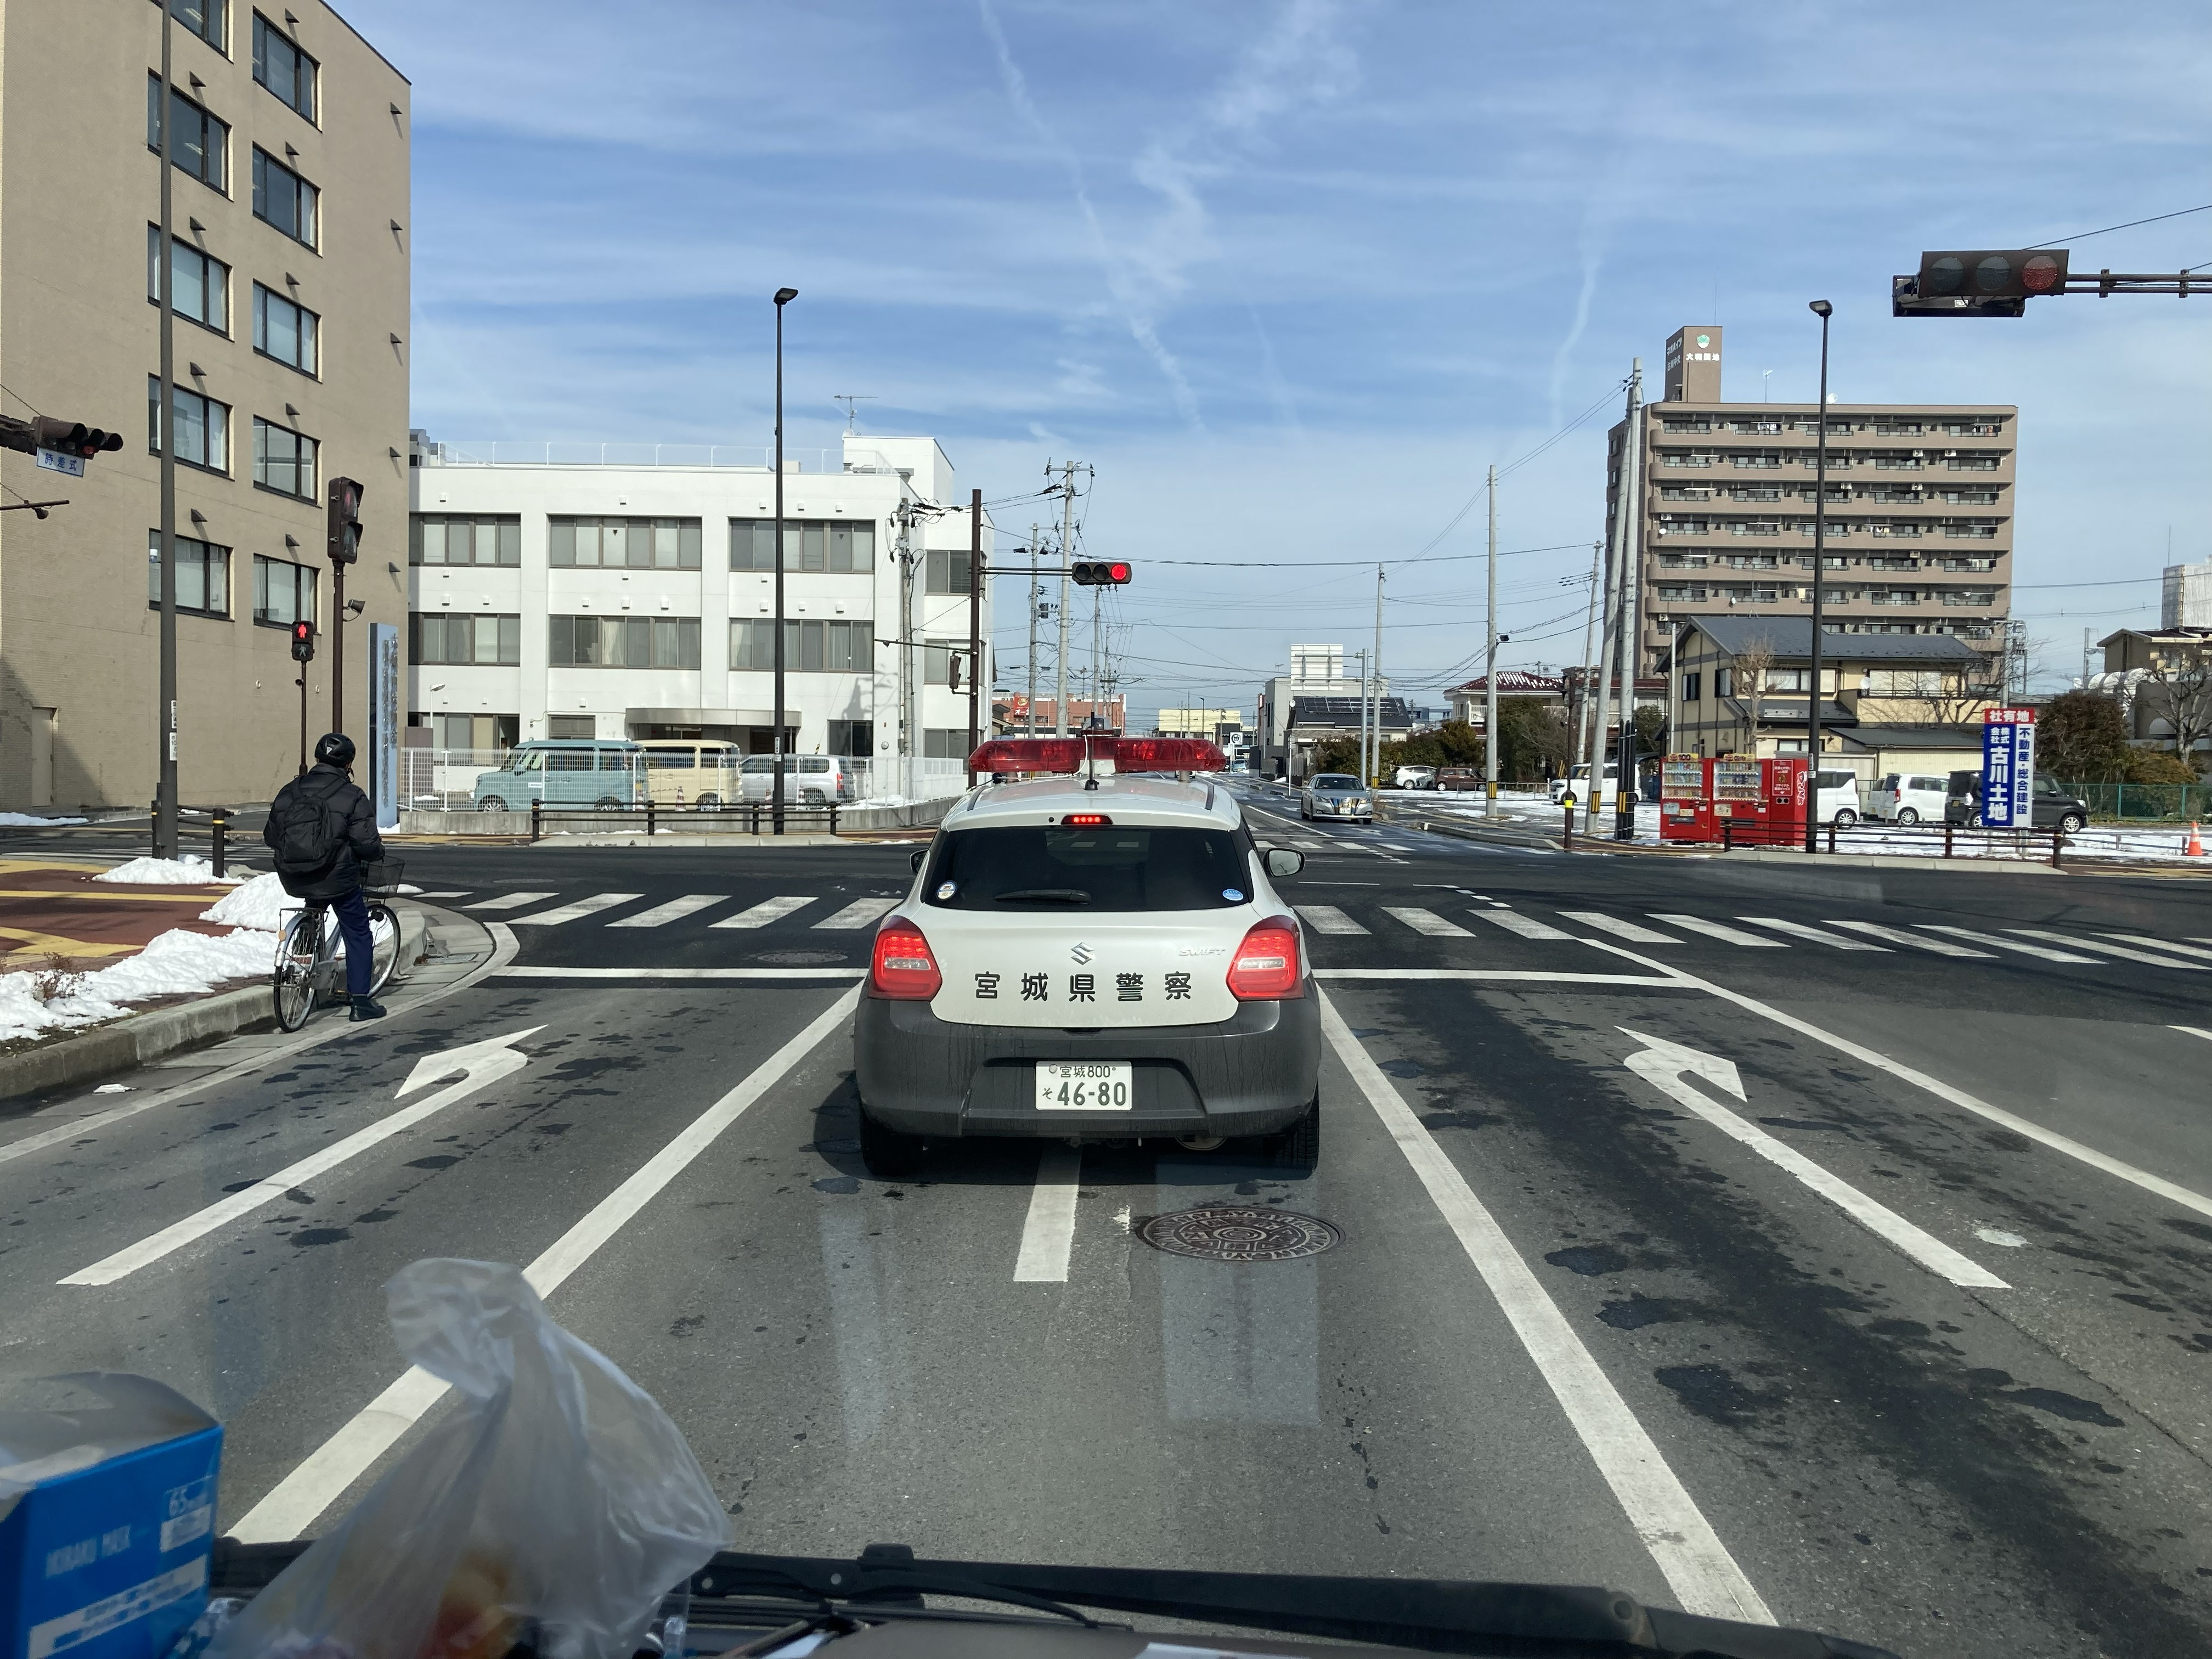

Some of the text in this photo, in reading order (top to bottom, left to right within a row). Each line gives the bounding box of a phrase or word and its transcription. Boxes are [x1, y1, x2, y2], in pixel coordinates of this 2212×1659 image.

[45, 453, 77, 471] 時差式
[1989, 710, 2030, 723] 社有地
[1988, 746, 2010, 821] 古川土地
[2016, 727, 2031, 815] 不動産・総合建設
[1179, 947, 1226, 956] SWIFT
[974, 970, 1192, 1002] 宮城県警察
[1042, 1081, 1126, 1106] そ 46-80
